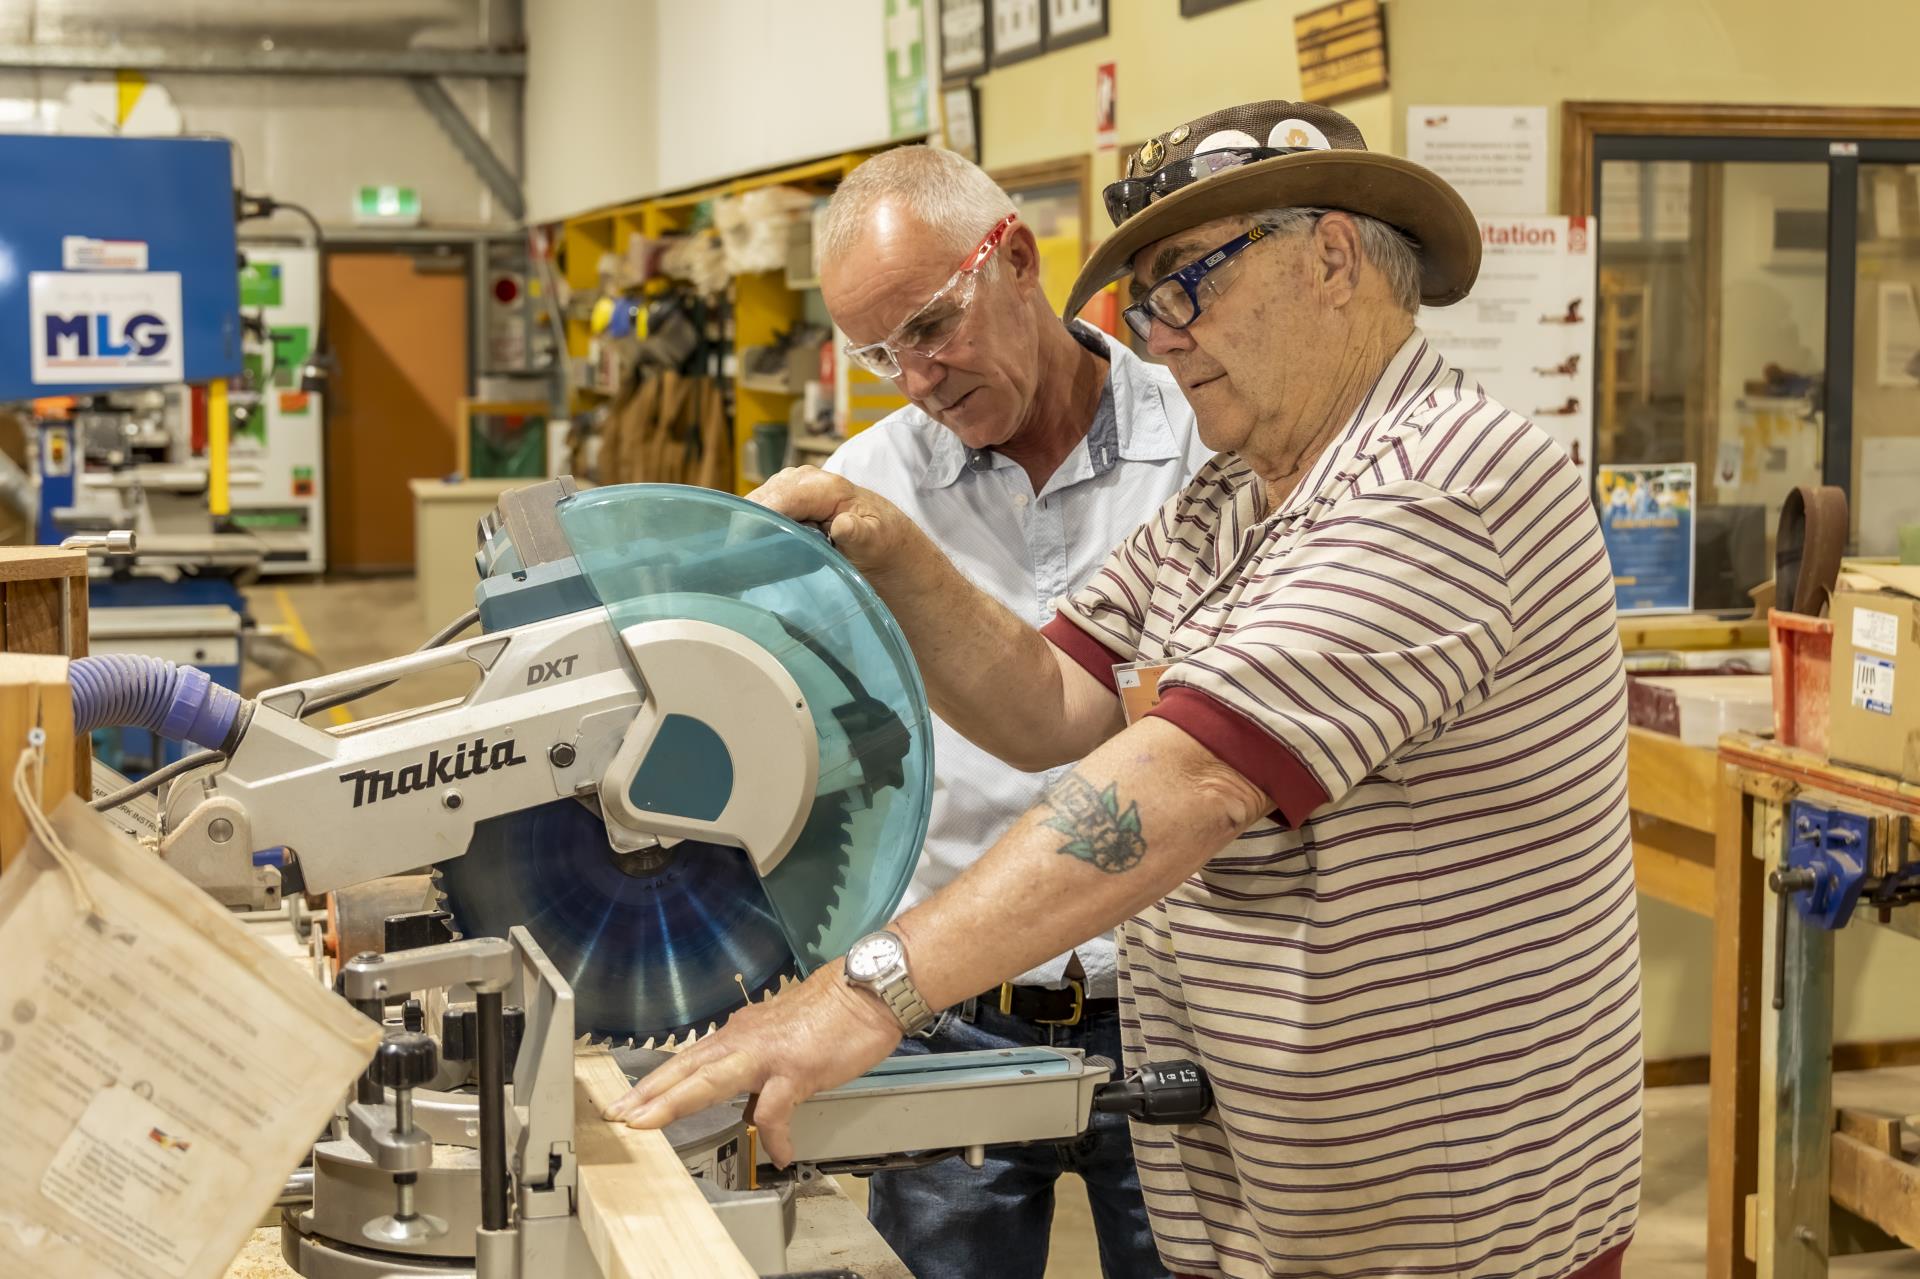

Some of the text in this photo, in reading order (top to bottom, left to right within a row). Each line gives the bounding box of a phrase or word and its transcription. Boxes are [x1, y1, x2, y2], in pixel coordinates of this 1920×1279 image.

[1481, 221, 1556, 245] itation
[46, 314, 167, 357] MLG
[527, 654, 579, 686] DXT
